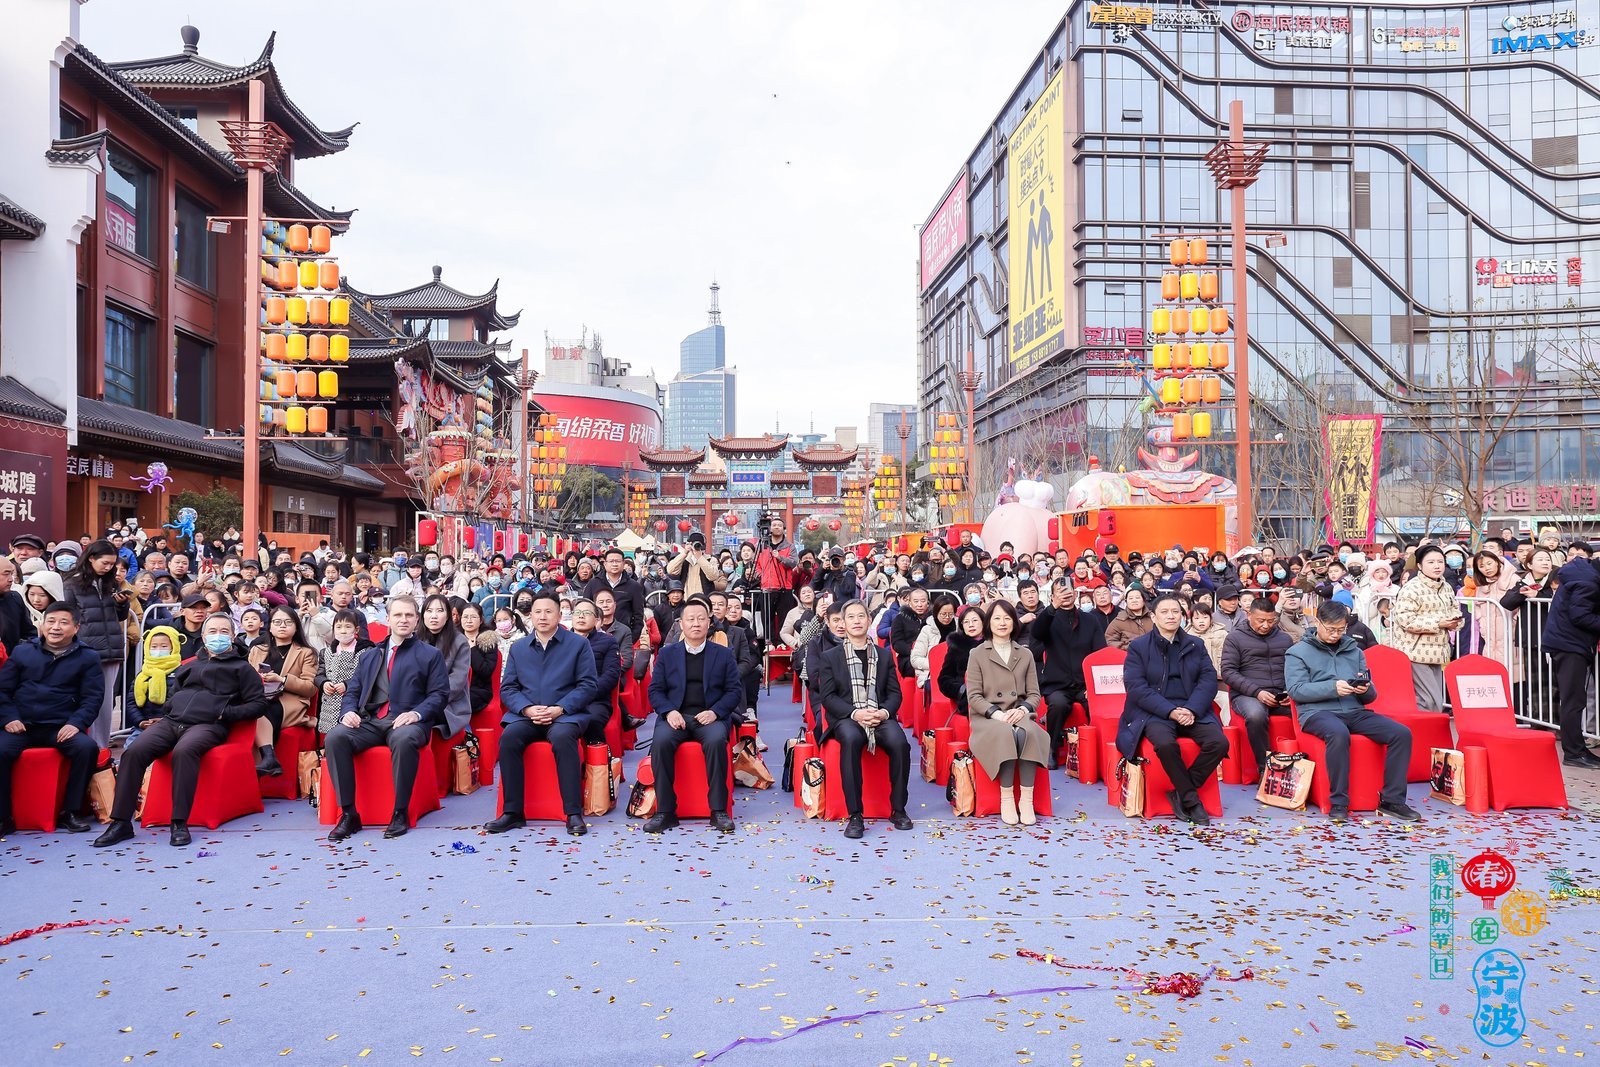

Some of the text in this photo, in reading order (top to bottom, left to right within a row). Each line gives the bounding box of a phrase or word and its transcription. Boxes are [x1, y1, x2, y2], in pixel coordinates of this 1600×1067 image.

[1255, 14, 1350, 34] 海底捞火锅
[1492, 30, 1578, 54] IMAX
[1011, 80, 1061, 156] MEETING POINT
[1503, 259, 1557, 274] 七欣天
[1047, 309, 1062, 332] MALL
[545, 416, 625, 442] 国绵柔香
[0, 470, 36, 495] 城隍
[0, 497, 36, 522] 有礼
[1466, 686, 1497, 698] 尹秋平
